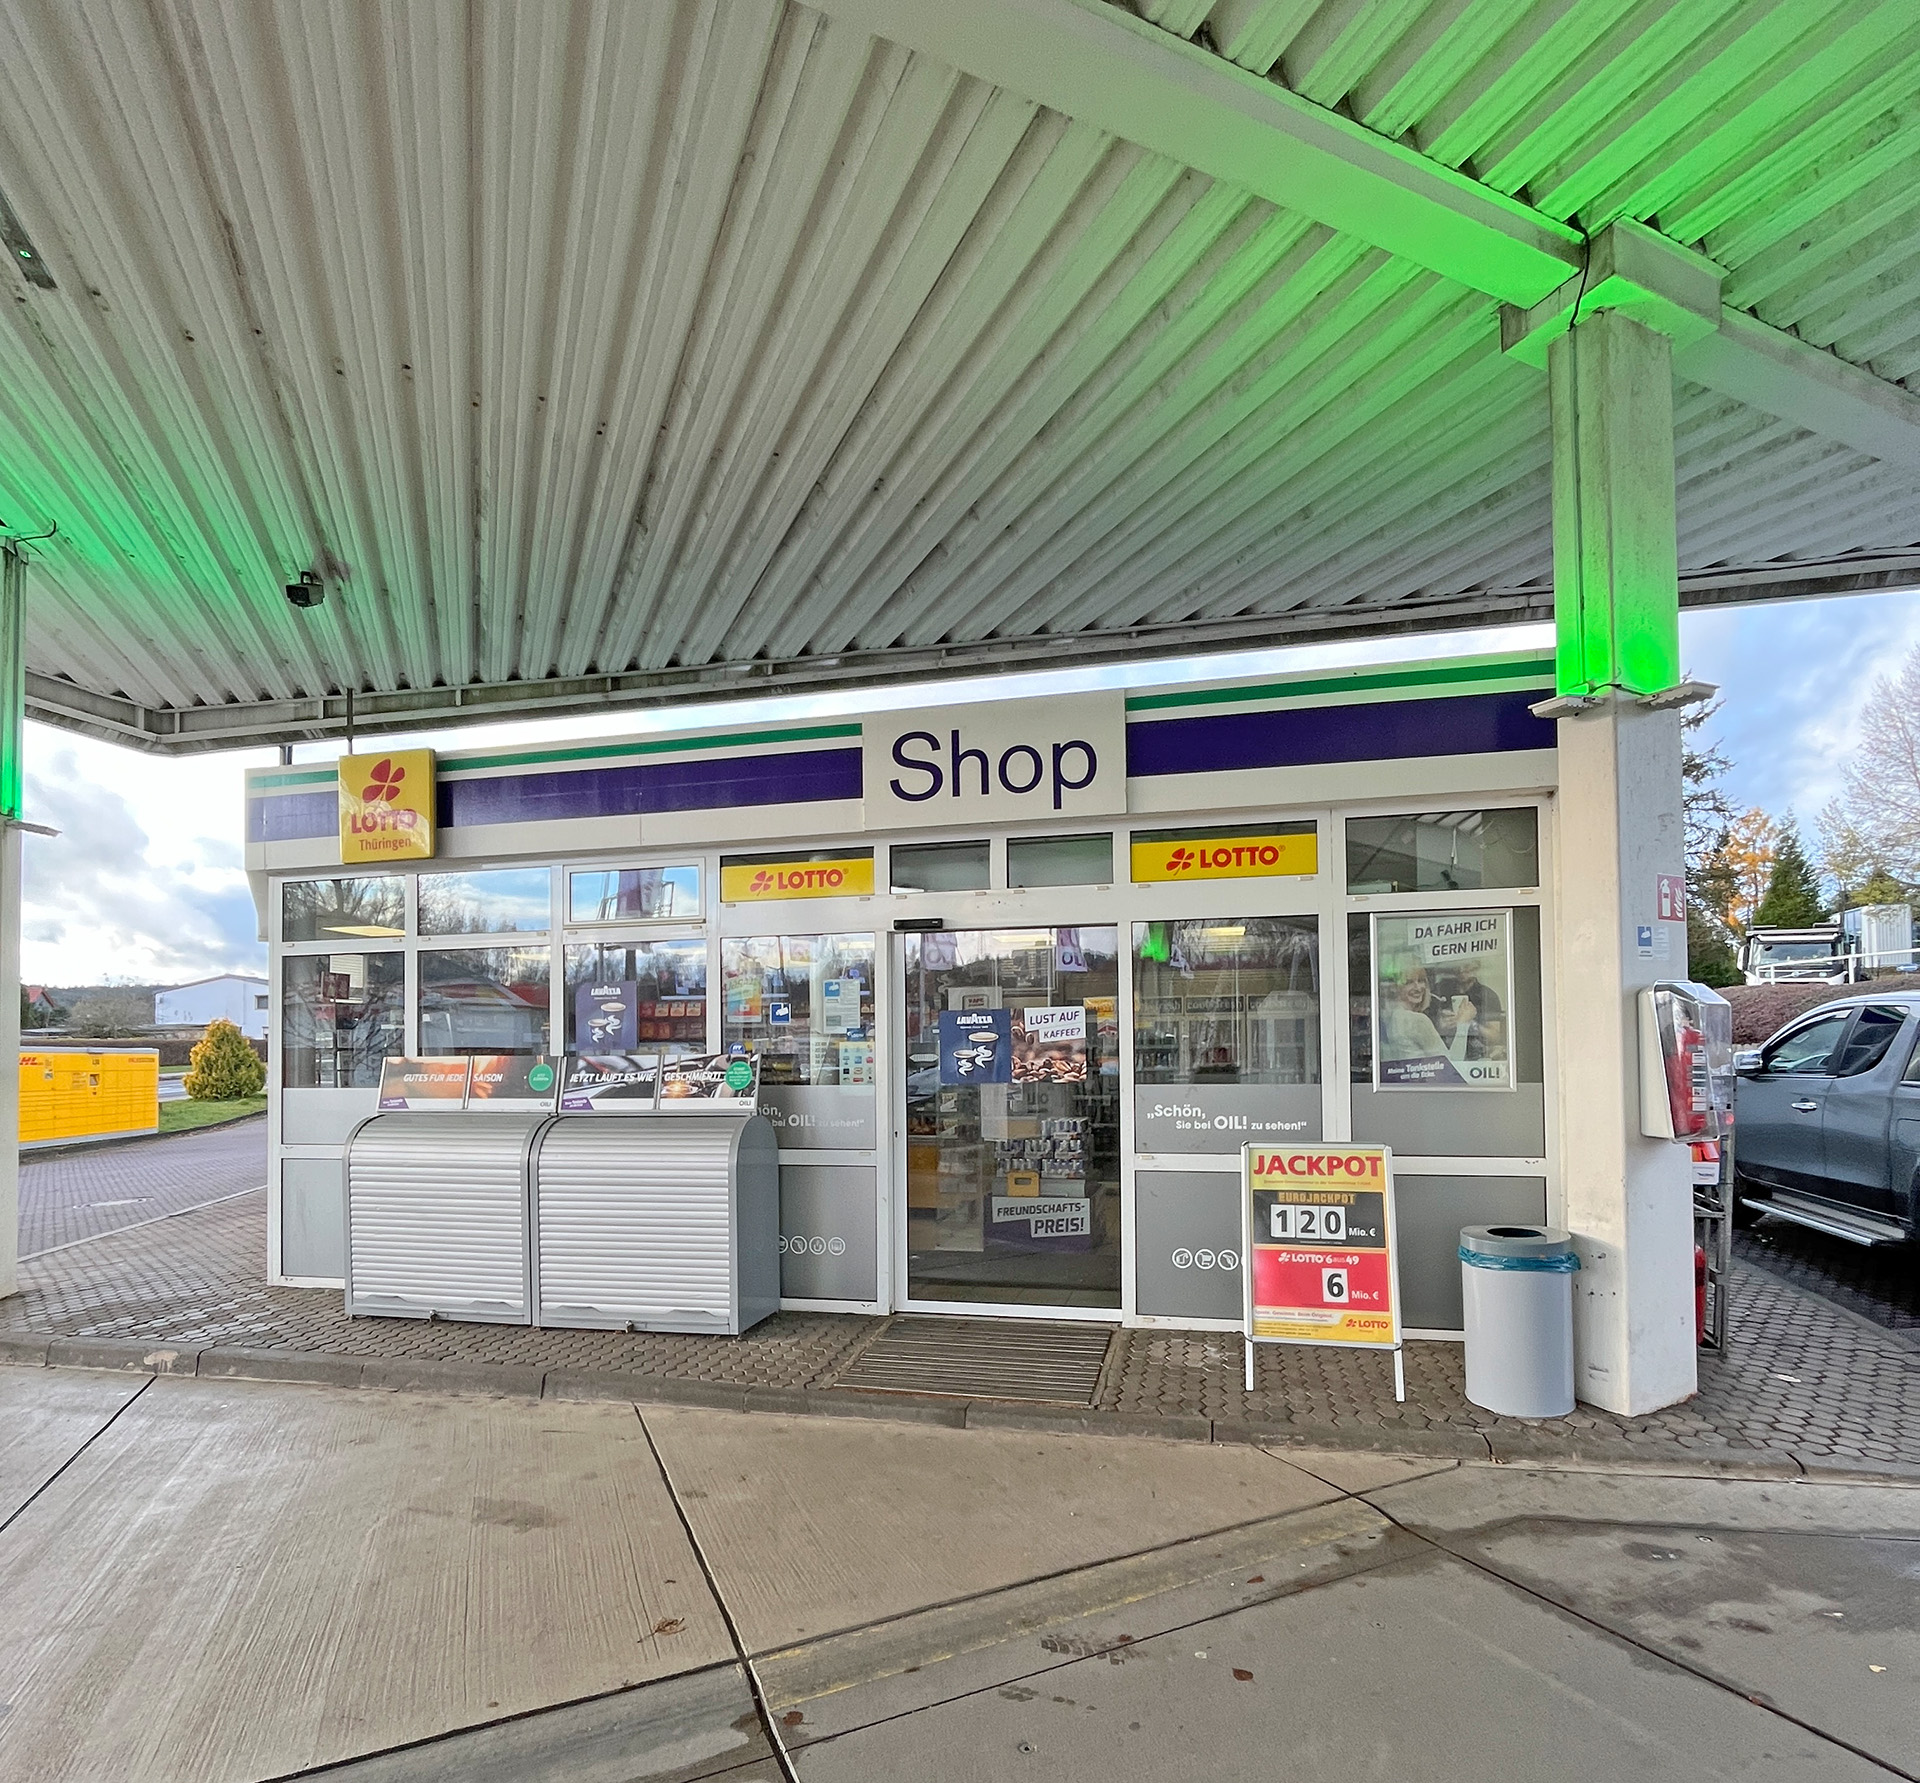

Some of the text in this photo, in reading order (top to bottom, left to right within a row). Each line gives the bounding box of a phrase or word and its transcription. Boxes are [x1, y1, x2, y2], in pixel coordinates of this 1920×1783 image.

[890, 730, 1097, 809] Shop
[351, 808, 418, 833] LOTTO
[359, 837, 411, 851] Thüringen
[1200, 845, 1279, 869] LOTTO
[778, 868, 843, 890] LOTTO
[1415, 918, 1497, 939] DA FAHR ICH
[1432, 939, 1498, 956] GERN HIN!
[590, 985, 621, 996] LAVAZZA
[957, 1013, 993, 1025] LAVAZZA
[1029, 1011, 1080, 1026] LUST AUF
[1043, 1027, 1081, 1039] KAFFEE?
[1406, 1061, 1445, 1073] Tankstelle
[1469, 1066, 1500, 1079] OIL!
[403, 1073, 429, 1082] GUTES
[446, 1073, 465, 1082] JEDE
[473, 1073, 503, 1082] SAISON
[570, 1073, 595, 1083] JETZT
[624, 1072, 635, 1082] ES
[637, 1072, 654, 1082] WIE
[771, 1119, 786, 1127] bei
[788, 1114, 816, 1127] OIL!
[1175, 1120, 1191, 1130] Sie
[1194, 1120, 1211, 1130] bei
[1214, 1115, 1248, 1130] OIL!
[1253, 1154, 1383, 1177] JACKPOT
[1278, 1191, 1356, 1205] EUROJACKPOT
[997, 1202, 1086, 1217] FREUNDSCHAFTS-
[1034, 1217, 1085, 1234] PREIS!
[1275, 1209, 1376, 1237] 120 Mio. €
[1291, 1252, 1324, 1264] LOTTO
[1327, 1273, 1379, 1300] 6 Mio. €
[1358, 1320, 1389, 1329] LOTTO
